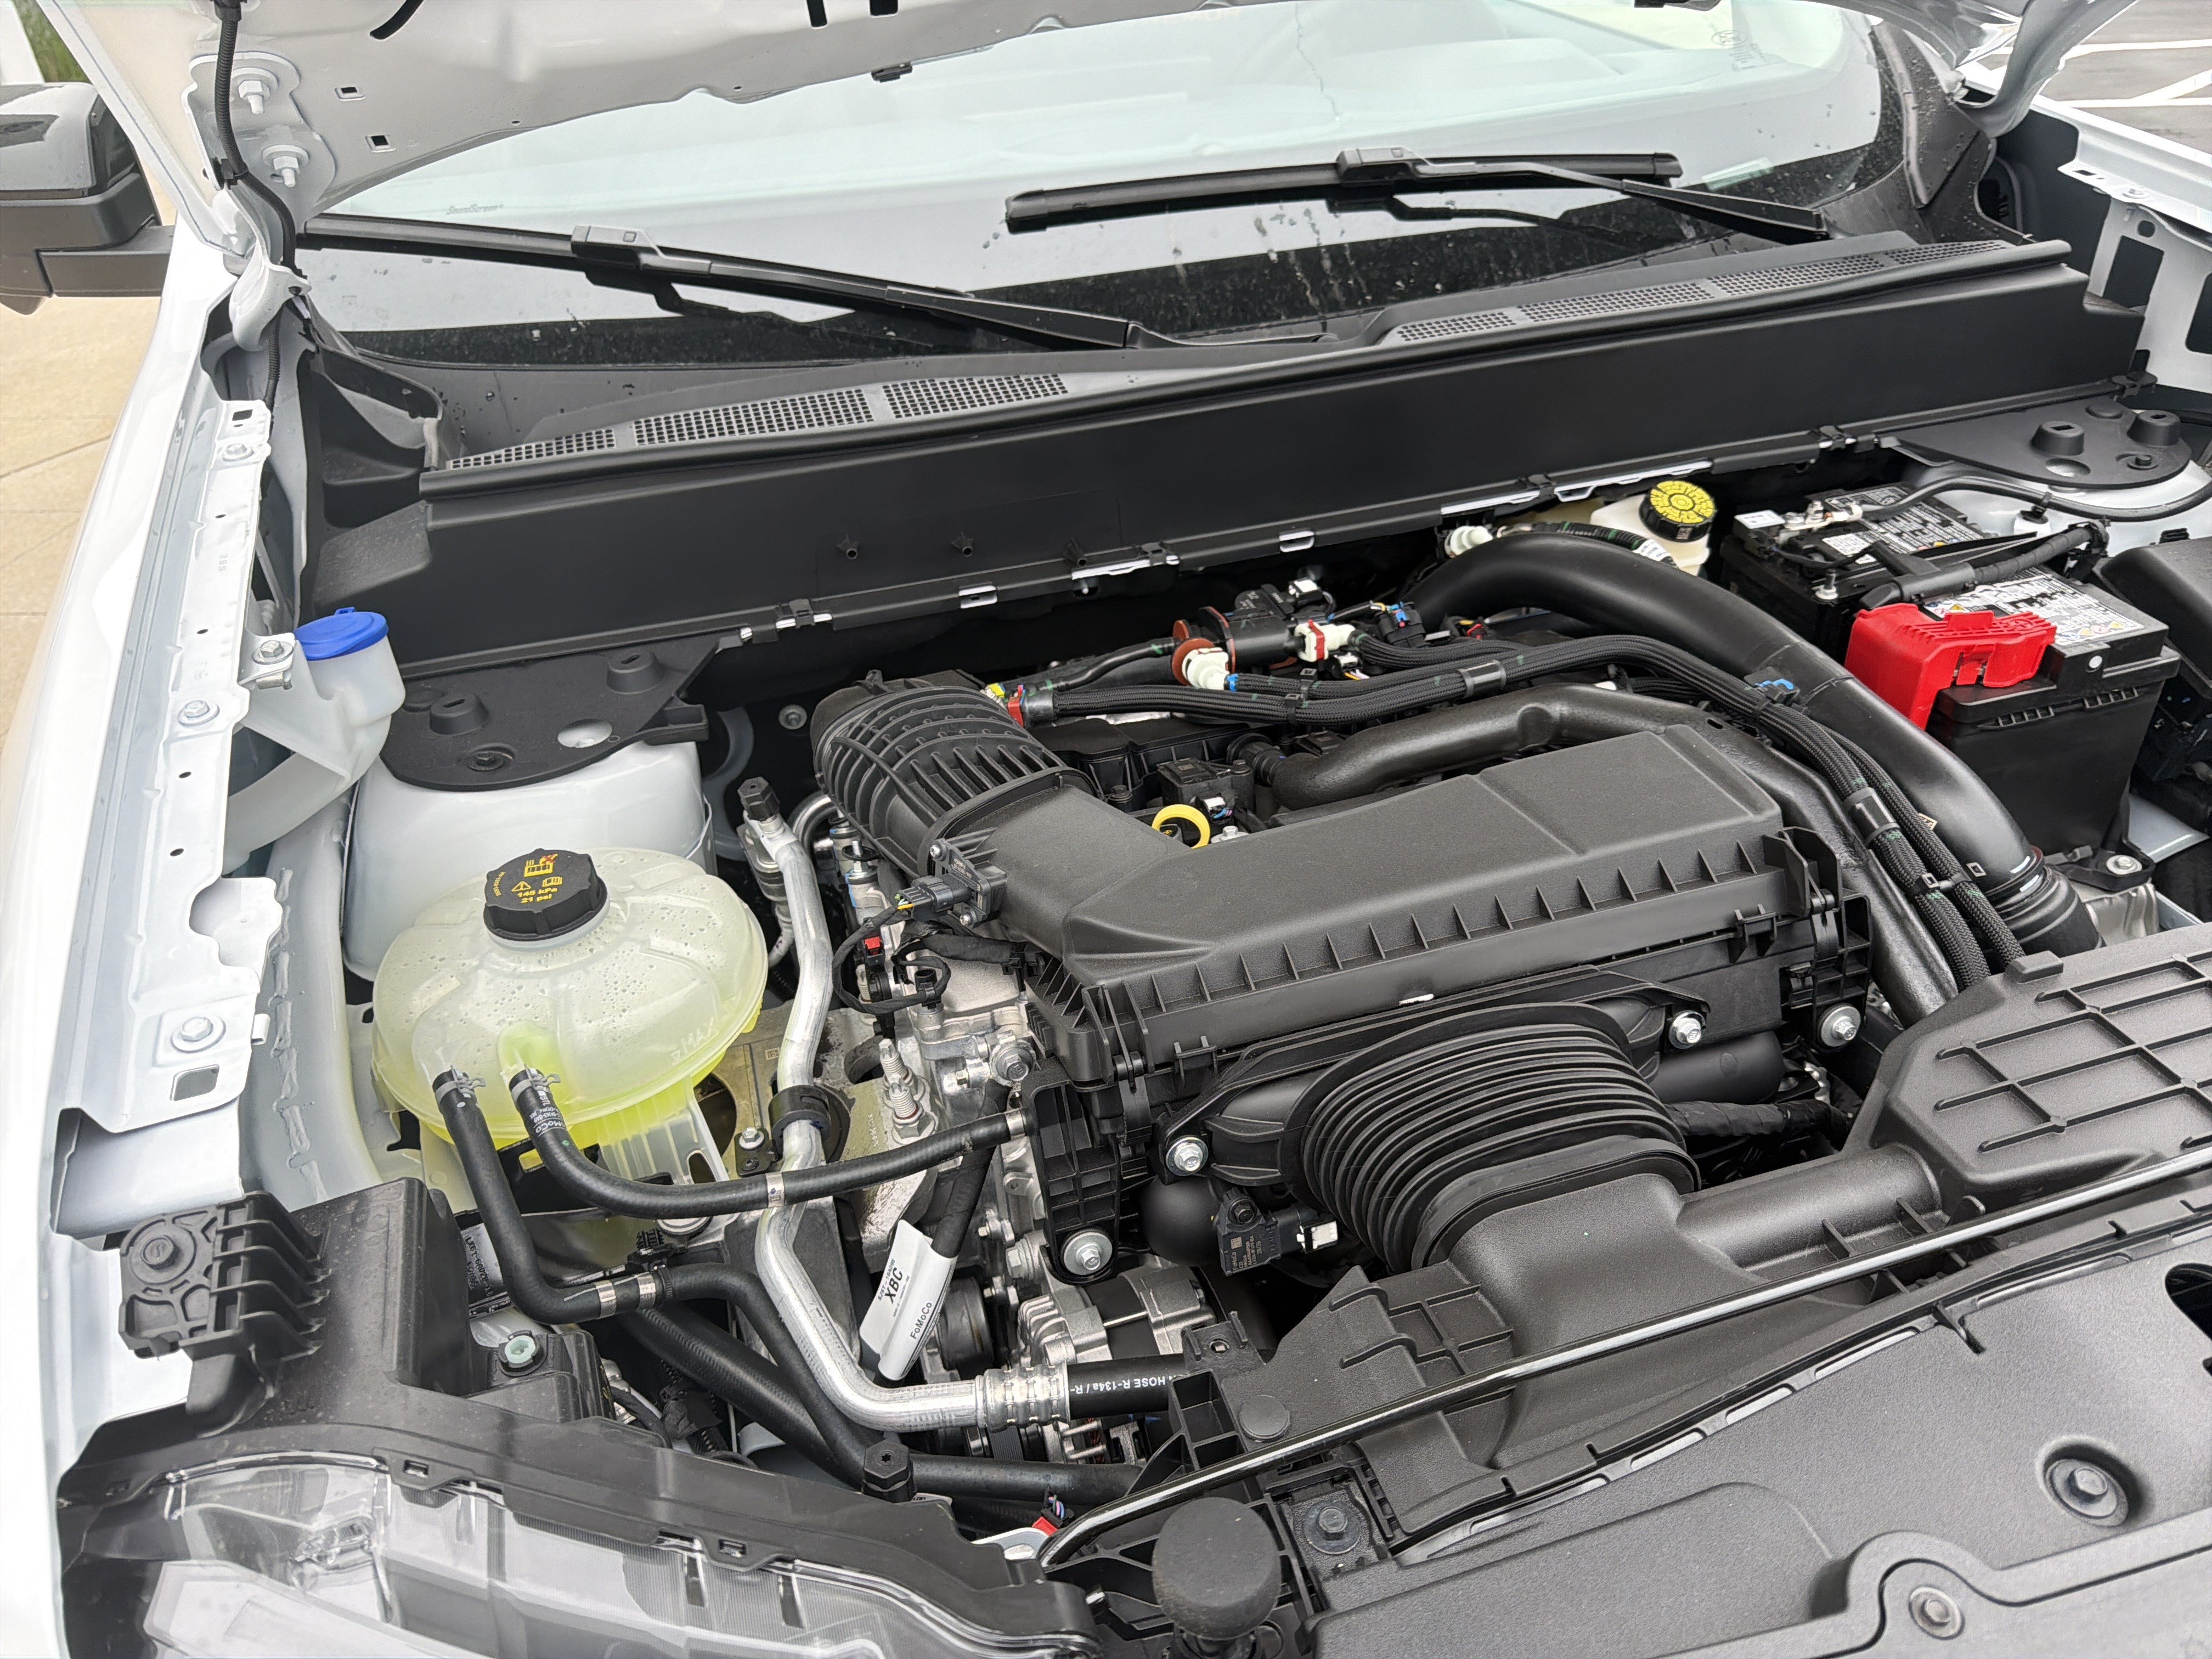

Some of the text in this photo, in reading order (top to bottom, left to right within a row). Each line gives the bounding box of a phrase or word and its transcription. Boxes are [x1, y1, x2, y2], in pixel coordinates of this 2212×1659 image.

[681, 1017, 716, 1053] MAX
[884, 1267, 903, 1305] XBC
[910, 1301, 932, 1340] FoMoCo
[1092, 1379, 1131, 1392] R-134a
[1133, 1375, 1166, 1388] HOSE
